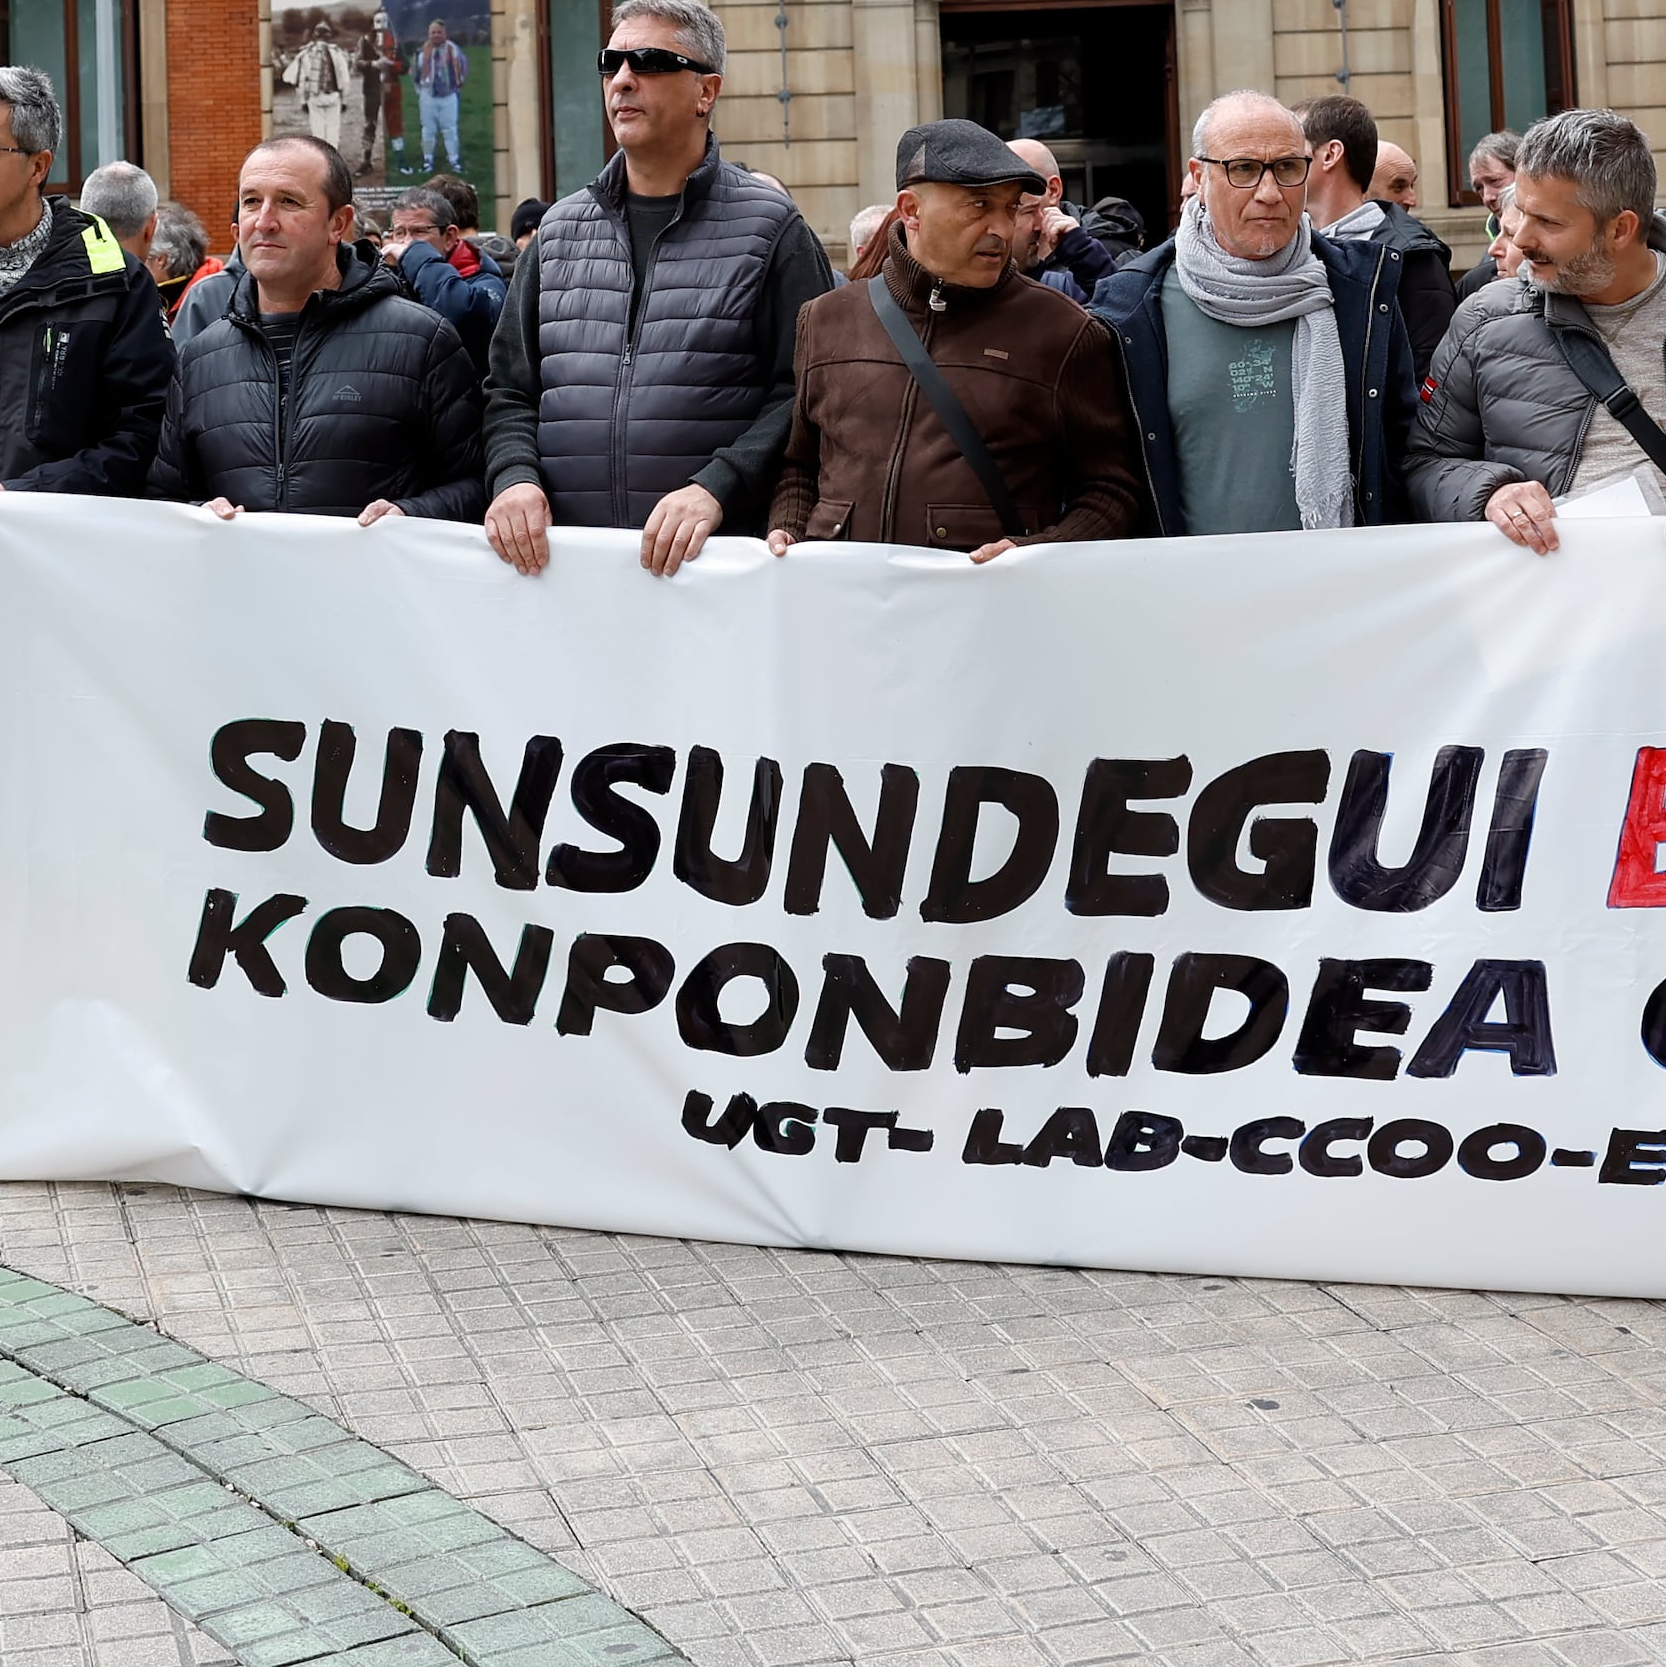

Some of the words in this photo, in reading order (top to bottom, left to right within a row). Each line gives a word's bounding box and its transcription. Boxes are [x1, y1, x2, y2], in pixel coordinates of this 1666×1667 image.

[204, 718, 1547, 924] SUNSUNDEGUI
[188, 888, 1557, 1080] KONPONBIDEA
[681, 1090, 935, 1163] UGT-
